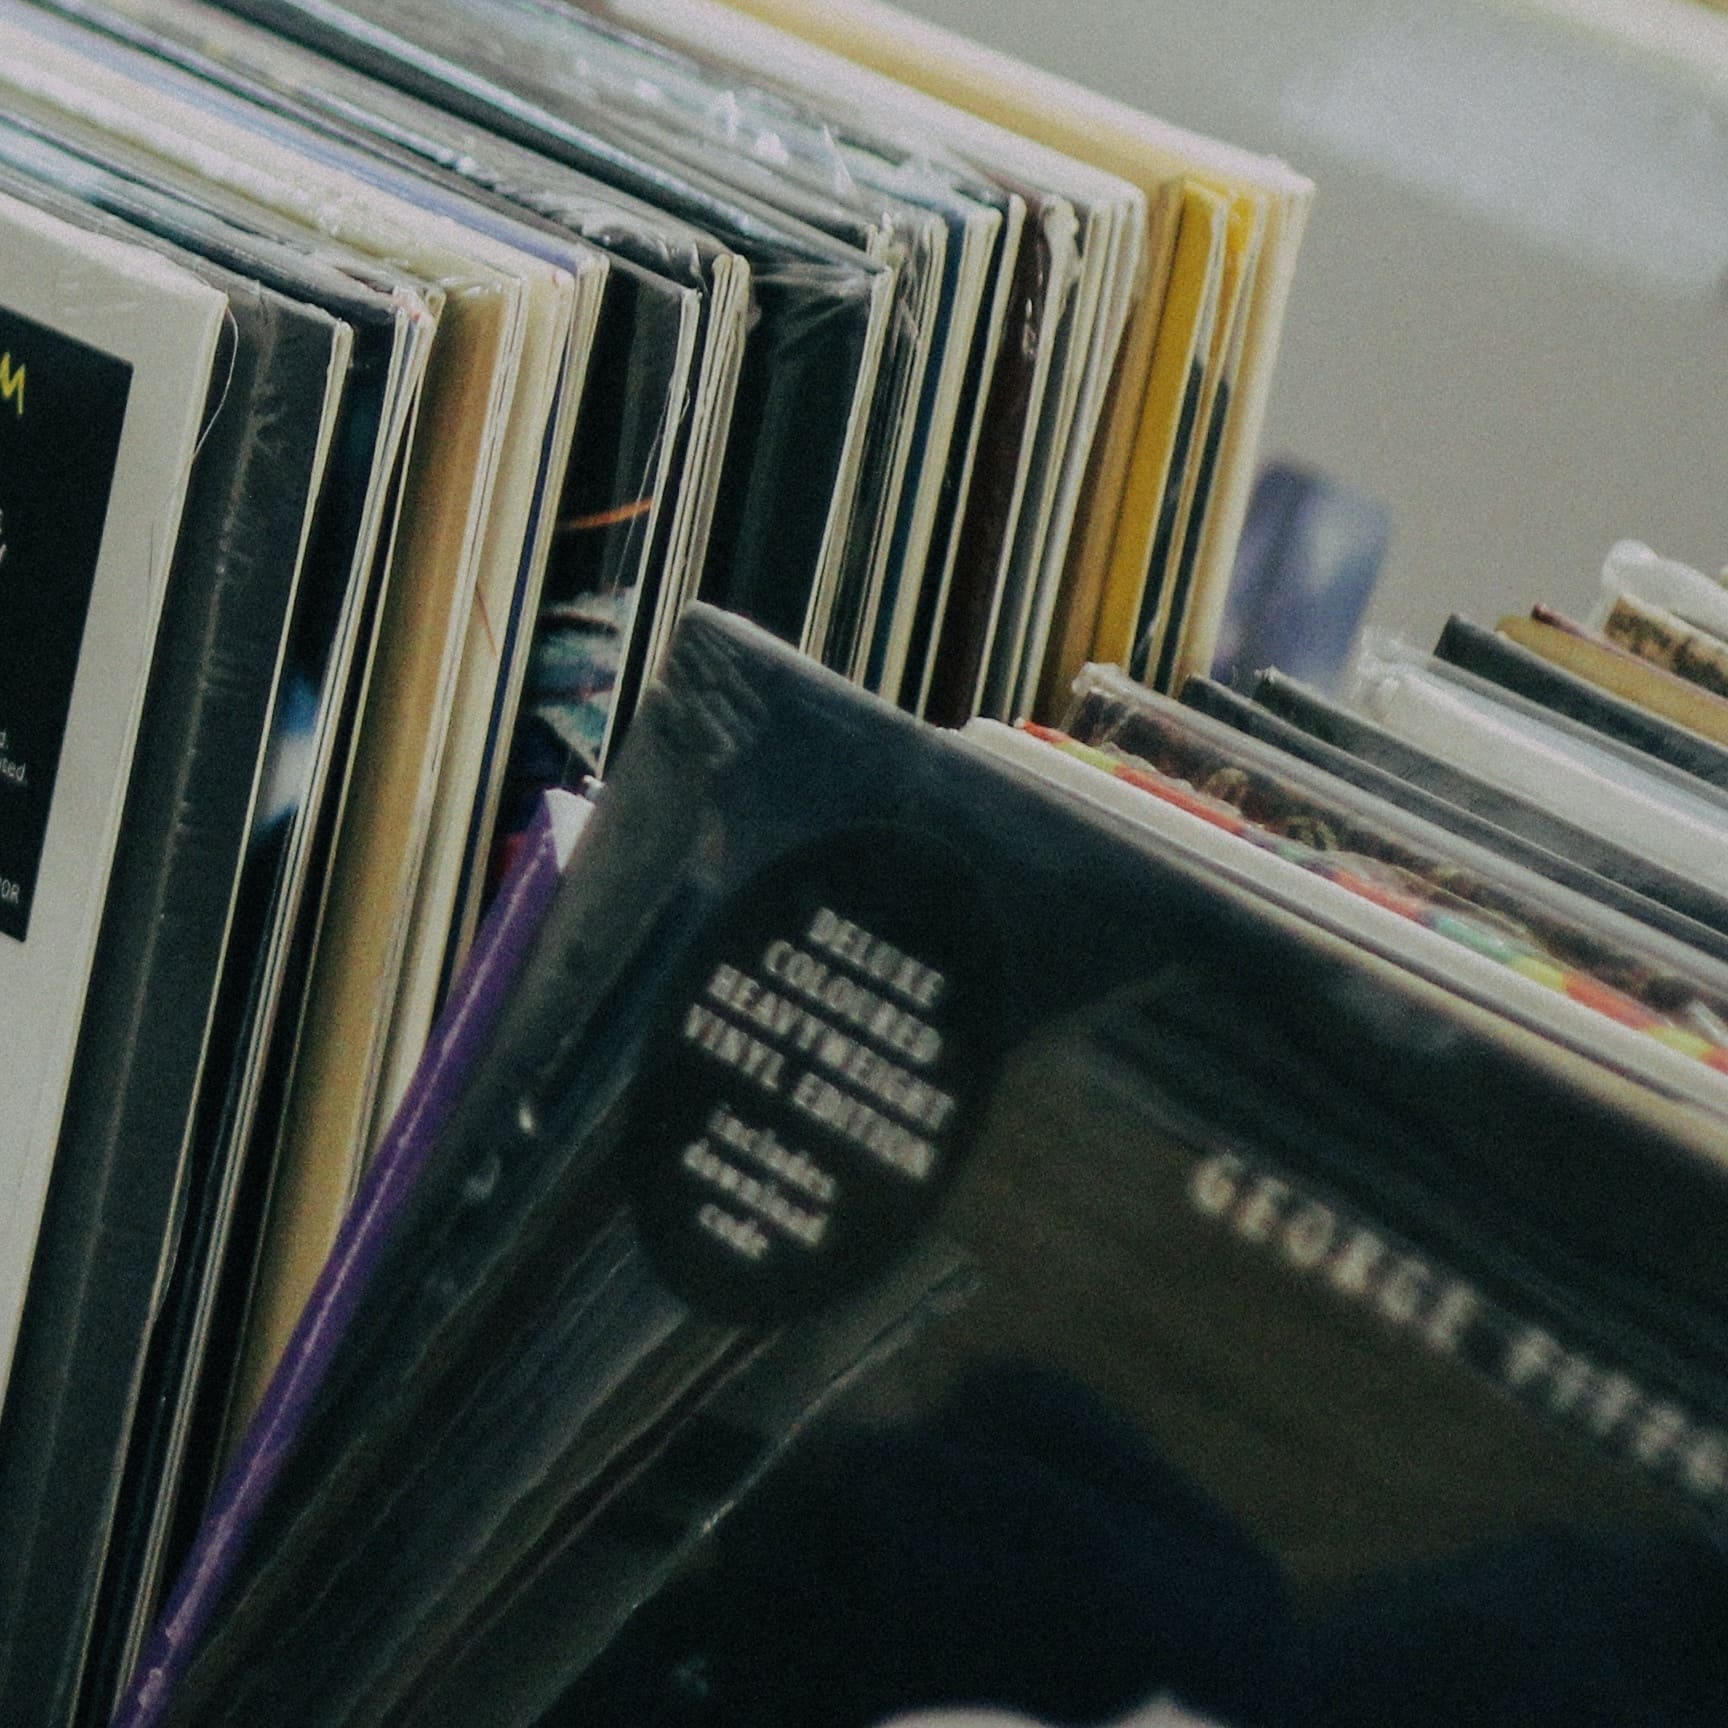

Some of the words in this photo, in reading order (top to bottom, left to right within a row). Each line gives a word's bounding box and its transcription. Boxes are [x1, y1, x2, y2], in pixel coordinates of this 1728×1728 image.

[764, 939, 943, 1063] COLOURED
[808, 906, 944, 1008] DELUXE
[684, 1003, 785, 1091] VINYL
[793, 1071, 935, 1180] EDITION
[707, 964, 955, 1131] HEAVYWEIGHT
[1190, 1151, 1479, 1354] GEORGE
